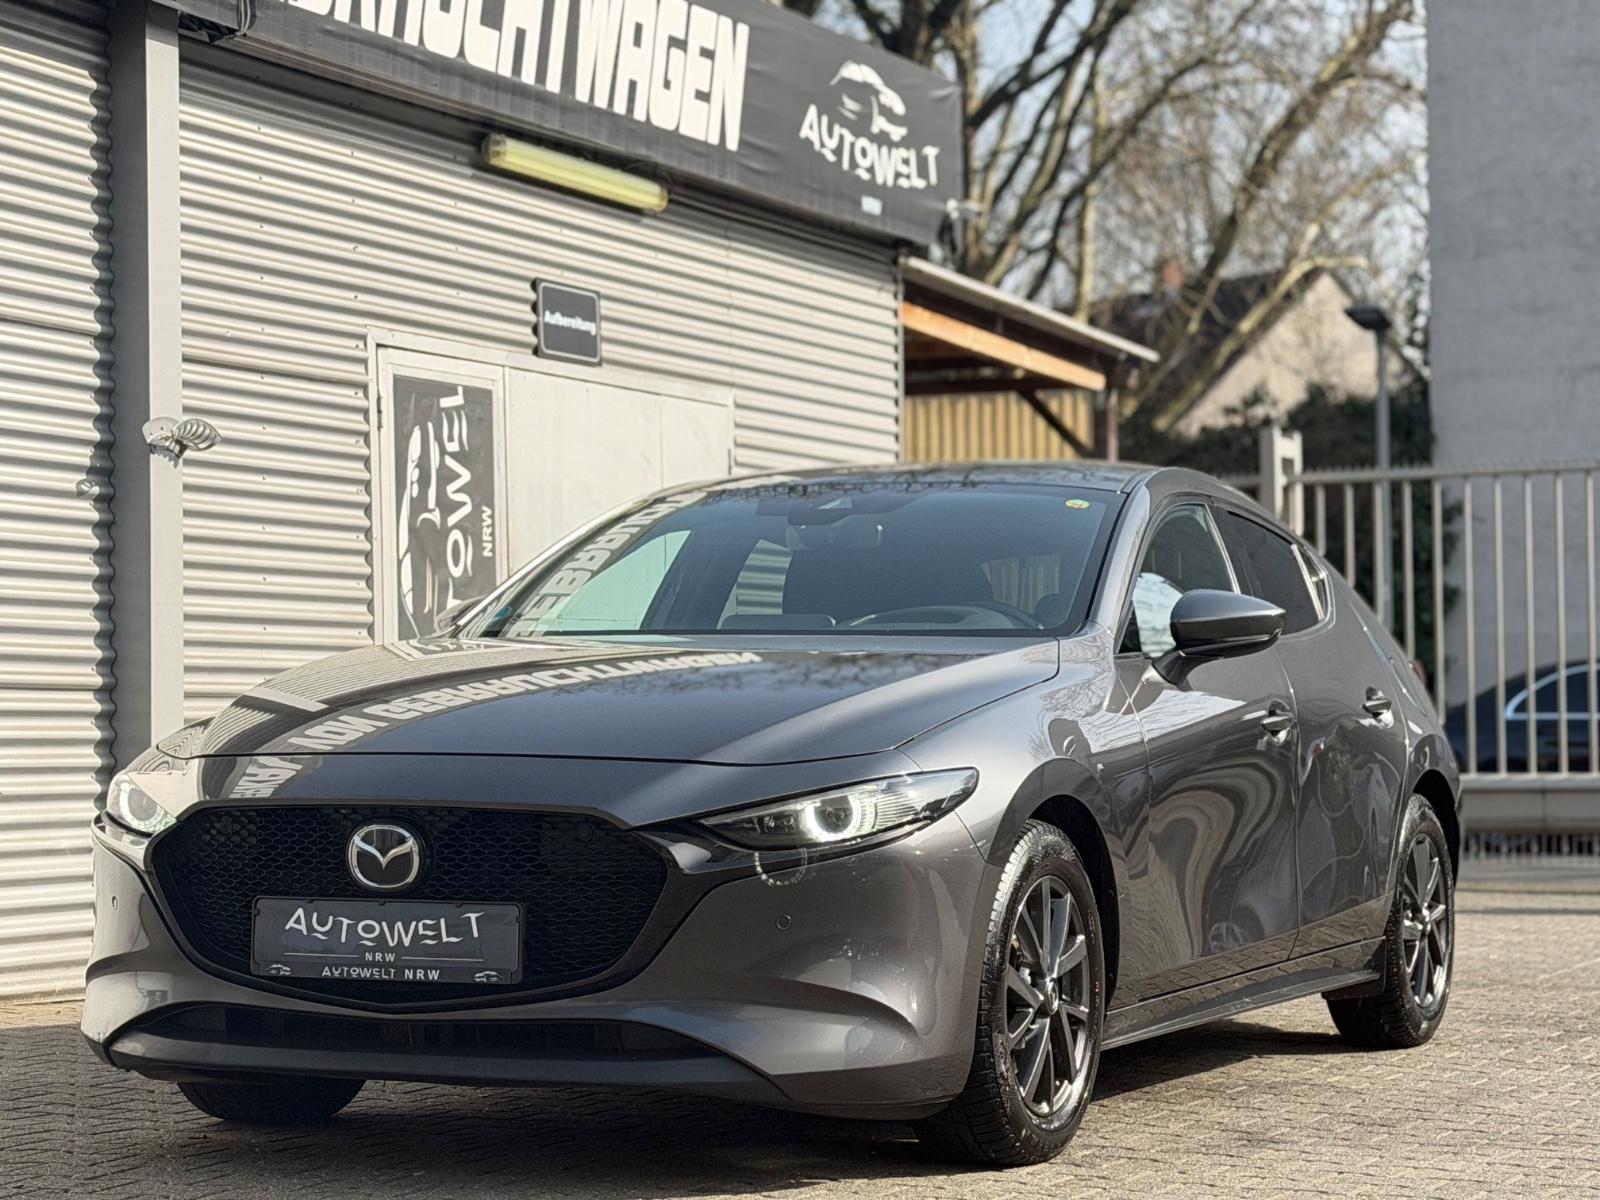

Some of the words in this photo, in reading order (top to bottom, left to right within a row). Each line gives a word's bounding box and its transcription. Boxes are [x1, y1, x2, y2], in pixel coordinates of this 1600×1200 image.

[799, 103, 941, 190] AUTOWELT
[482, 505, 493, 557] NRW
[284, 907, 485, 947] AUTOWELT
[321, 965, 397, 980] AUTOWELT
[403, 968, 441, 981] NRW
[364, 951, 396, 963] NRW
